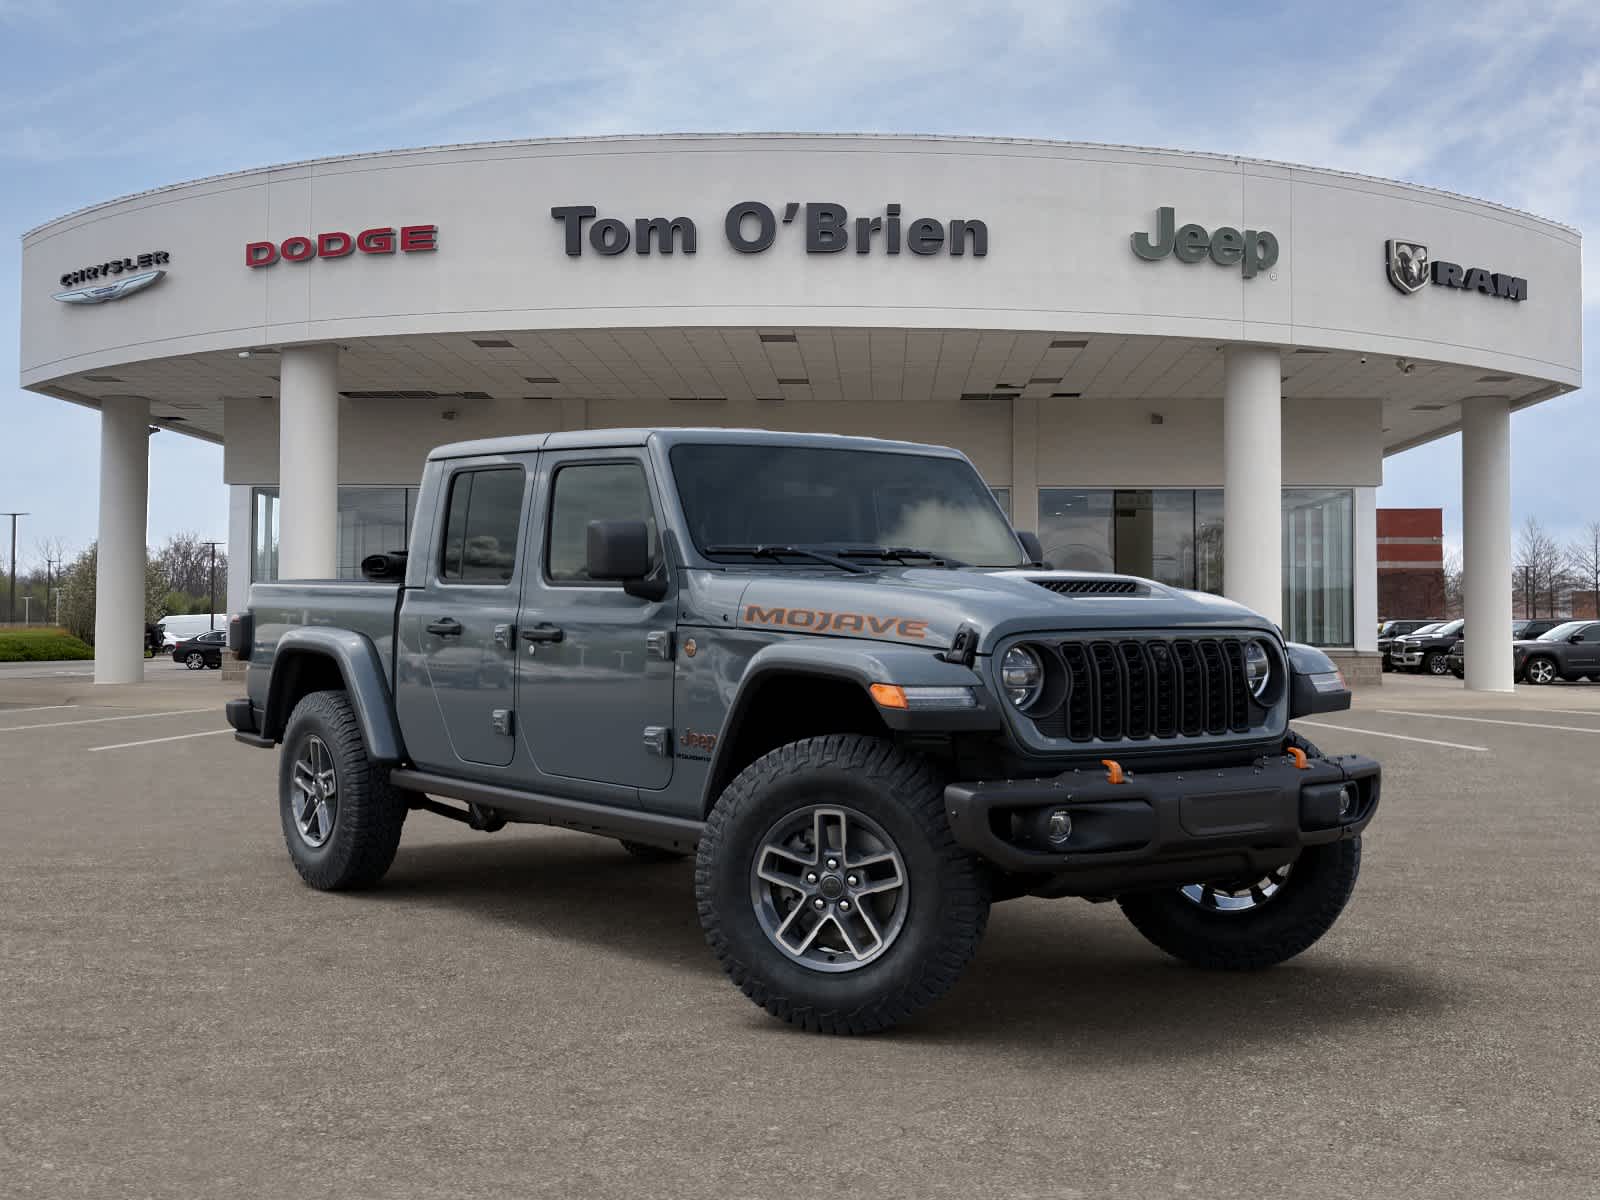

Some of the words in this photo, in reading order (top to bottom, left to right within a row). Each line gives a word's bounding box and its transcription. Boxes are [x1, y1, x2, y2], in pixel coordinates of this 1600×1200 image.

[245, 224, 437, 268] DODGE
[551, 205, 697, 257] Tom
[724, 201, 988, 257] O'Brien
[1131, 206, 1279, 278] Jeep
[60, 250, 169, 286] CHRYSLER
[1430, 260, 1527, 301] RAM
[745, 604, 928, 639] MOJAVE
